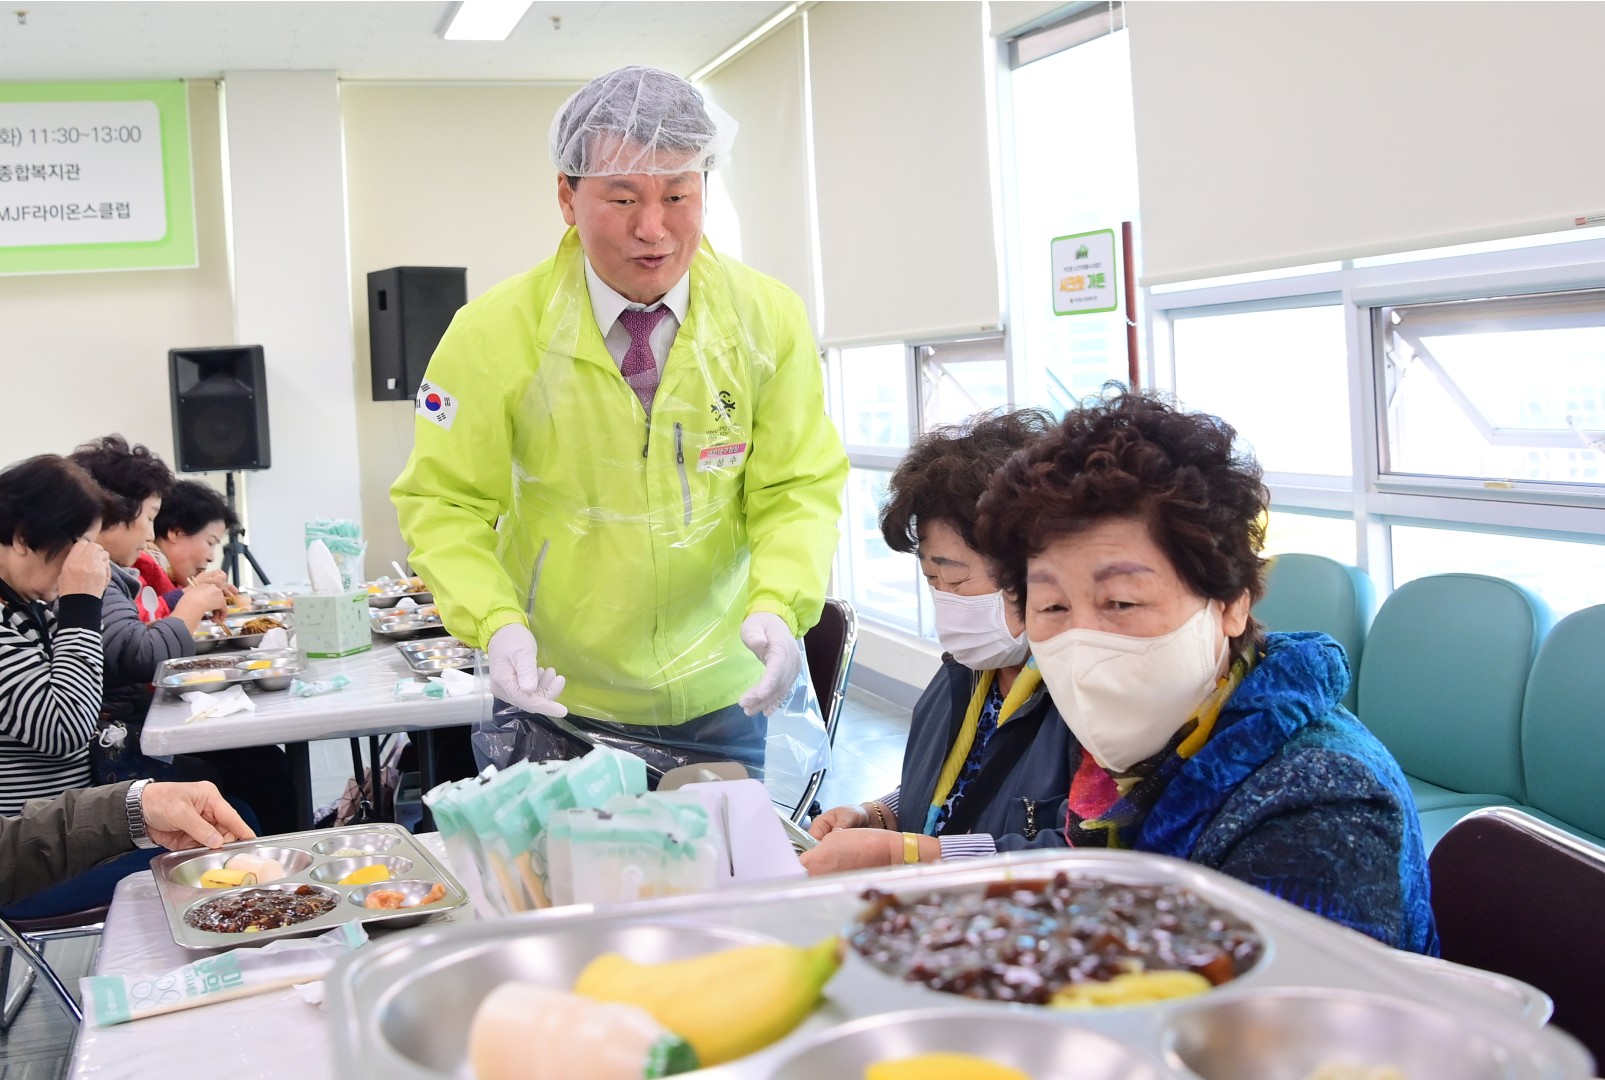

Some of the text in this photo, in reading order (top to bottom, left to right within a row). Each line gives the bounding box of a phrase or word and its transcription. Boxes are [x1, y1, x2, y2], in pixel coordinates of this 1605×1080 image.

[29, 125, 142, 144] 11:30~13:00
[0, 163, 81, 182] 종합복지관
[0, 202, 131, 222] MJF라이온스클럽
